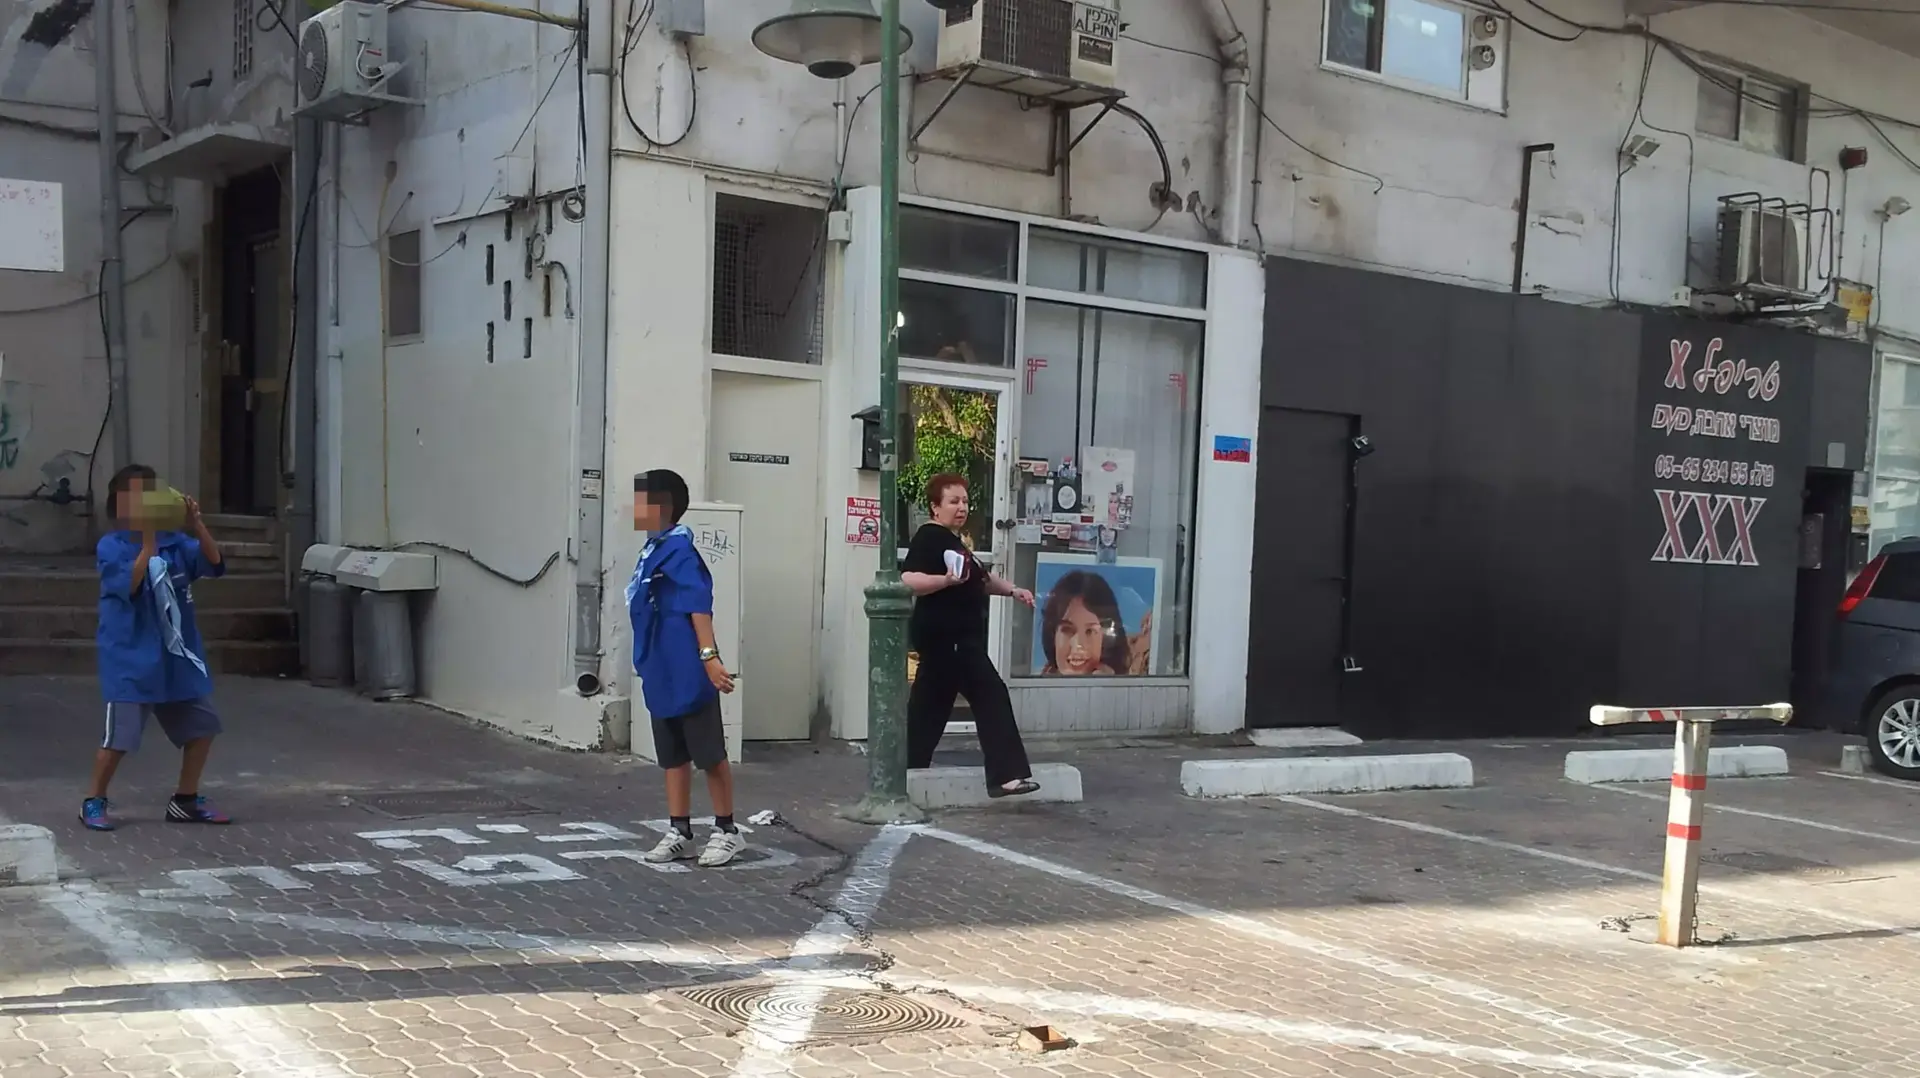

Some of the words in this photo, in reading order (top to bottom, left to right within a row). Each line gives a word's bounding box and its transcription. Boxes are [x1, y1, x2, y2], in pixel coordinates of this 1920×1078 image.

[1664, 339, 1692, 389] X
[1693, 338, 1780, 401] טריפל
[1739, 414, 1779, 443] מוצרי
[1730, 461, 1748, 485] 55
[1650, 489, 1767, 566] XXX
